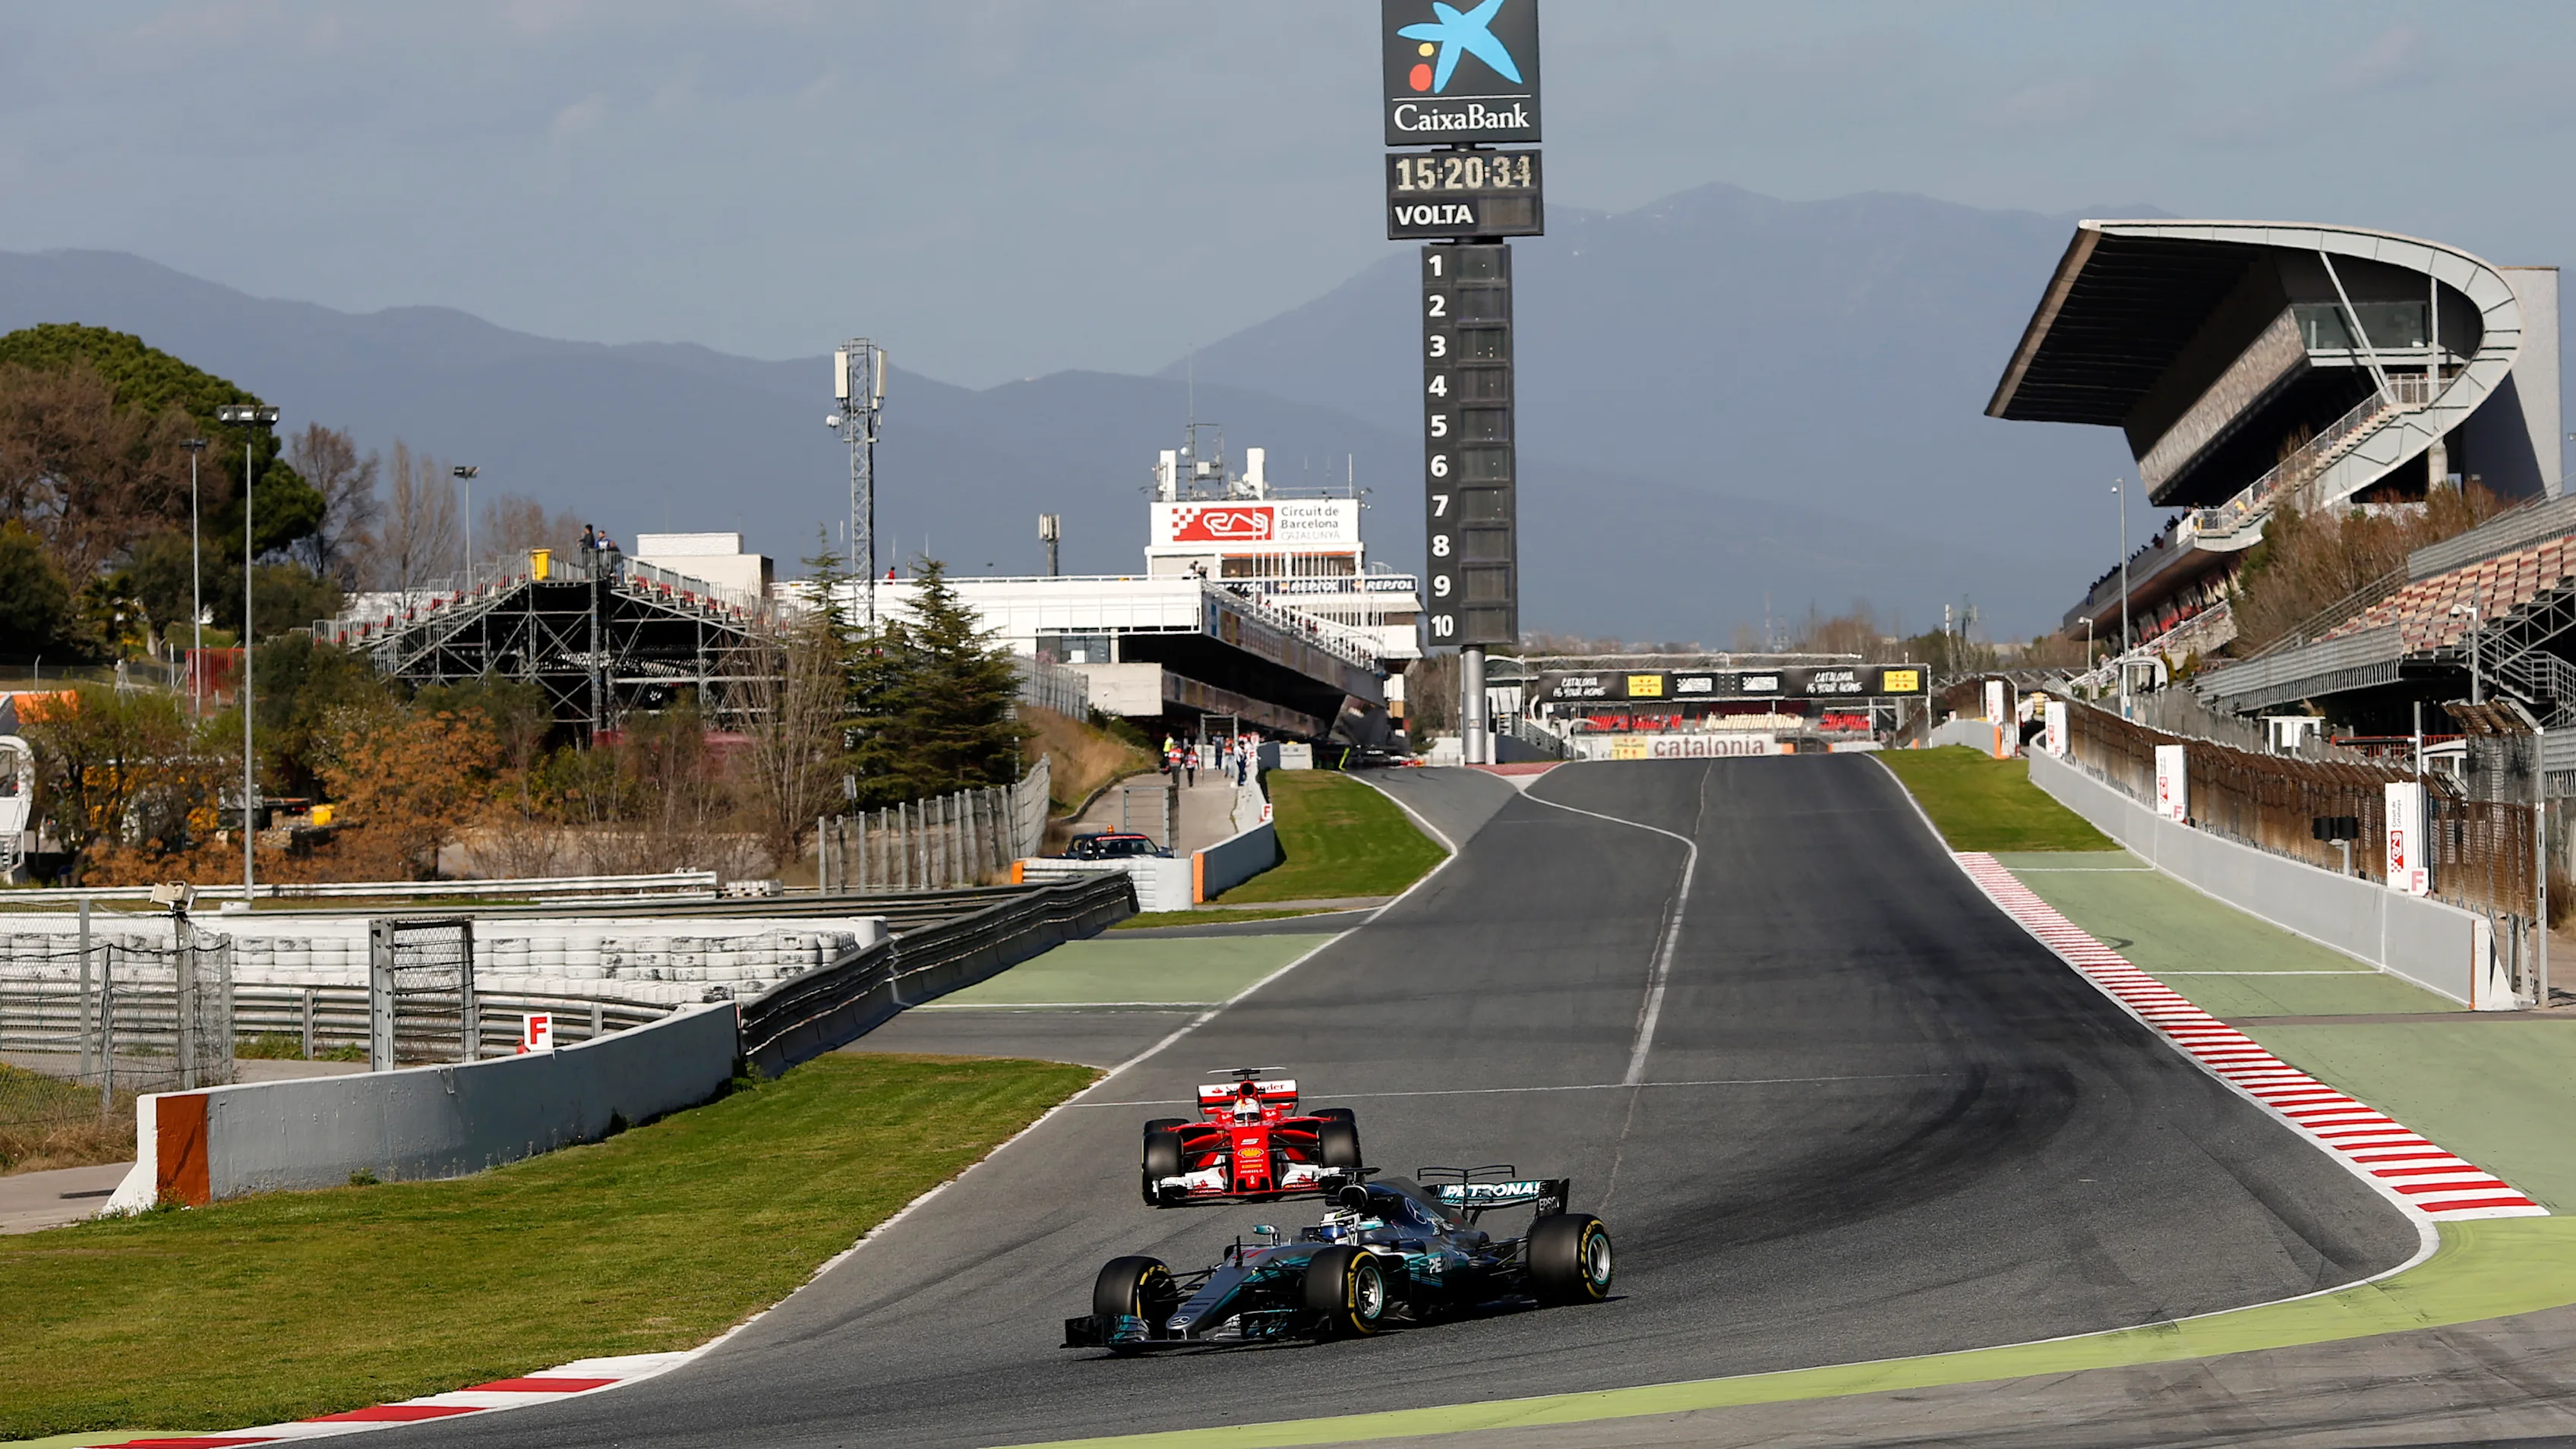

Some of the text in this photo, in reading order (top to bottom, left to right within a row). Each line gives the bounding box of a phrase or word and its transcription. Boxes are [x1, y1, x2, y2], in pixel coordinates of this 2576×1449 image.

[1394, 103, 1530, 131] CaixaBank
[1395, 204, 1474, 226] VOLTA
[1428, 254, 1442, 276] 1
[1428, 295, 1446, 317] 2
[1429, 335, 1446, 357] 3
[1428, 375, 1447, 397] 4
[1431, 415, 1447, 437] 5
[1431, 454, 1448, 477] 6
[1281, 506, 1339, 516] Circuit de
[1432, 494, 1449, 517] 7
[1281, 519, 1338, 529] Barcelona
[1281, 531, 1340, 540] CATALUNYA
[1432, 535, 1450, 557] 8
[1367, 580, 1413, 590] REPSOL
[1433, 575, 1451, 598] 9
[1432, 614, 1454, 636] 10
[1654, 736, 1765, 757] catalonia
[1263, 806, 1271, 817] F
[2174, 806, 2183, 819] F
[2411, 871, 2424, 892] F
[530, 1016, 548, 1044] F
